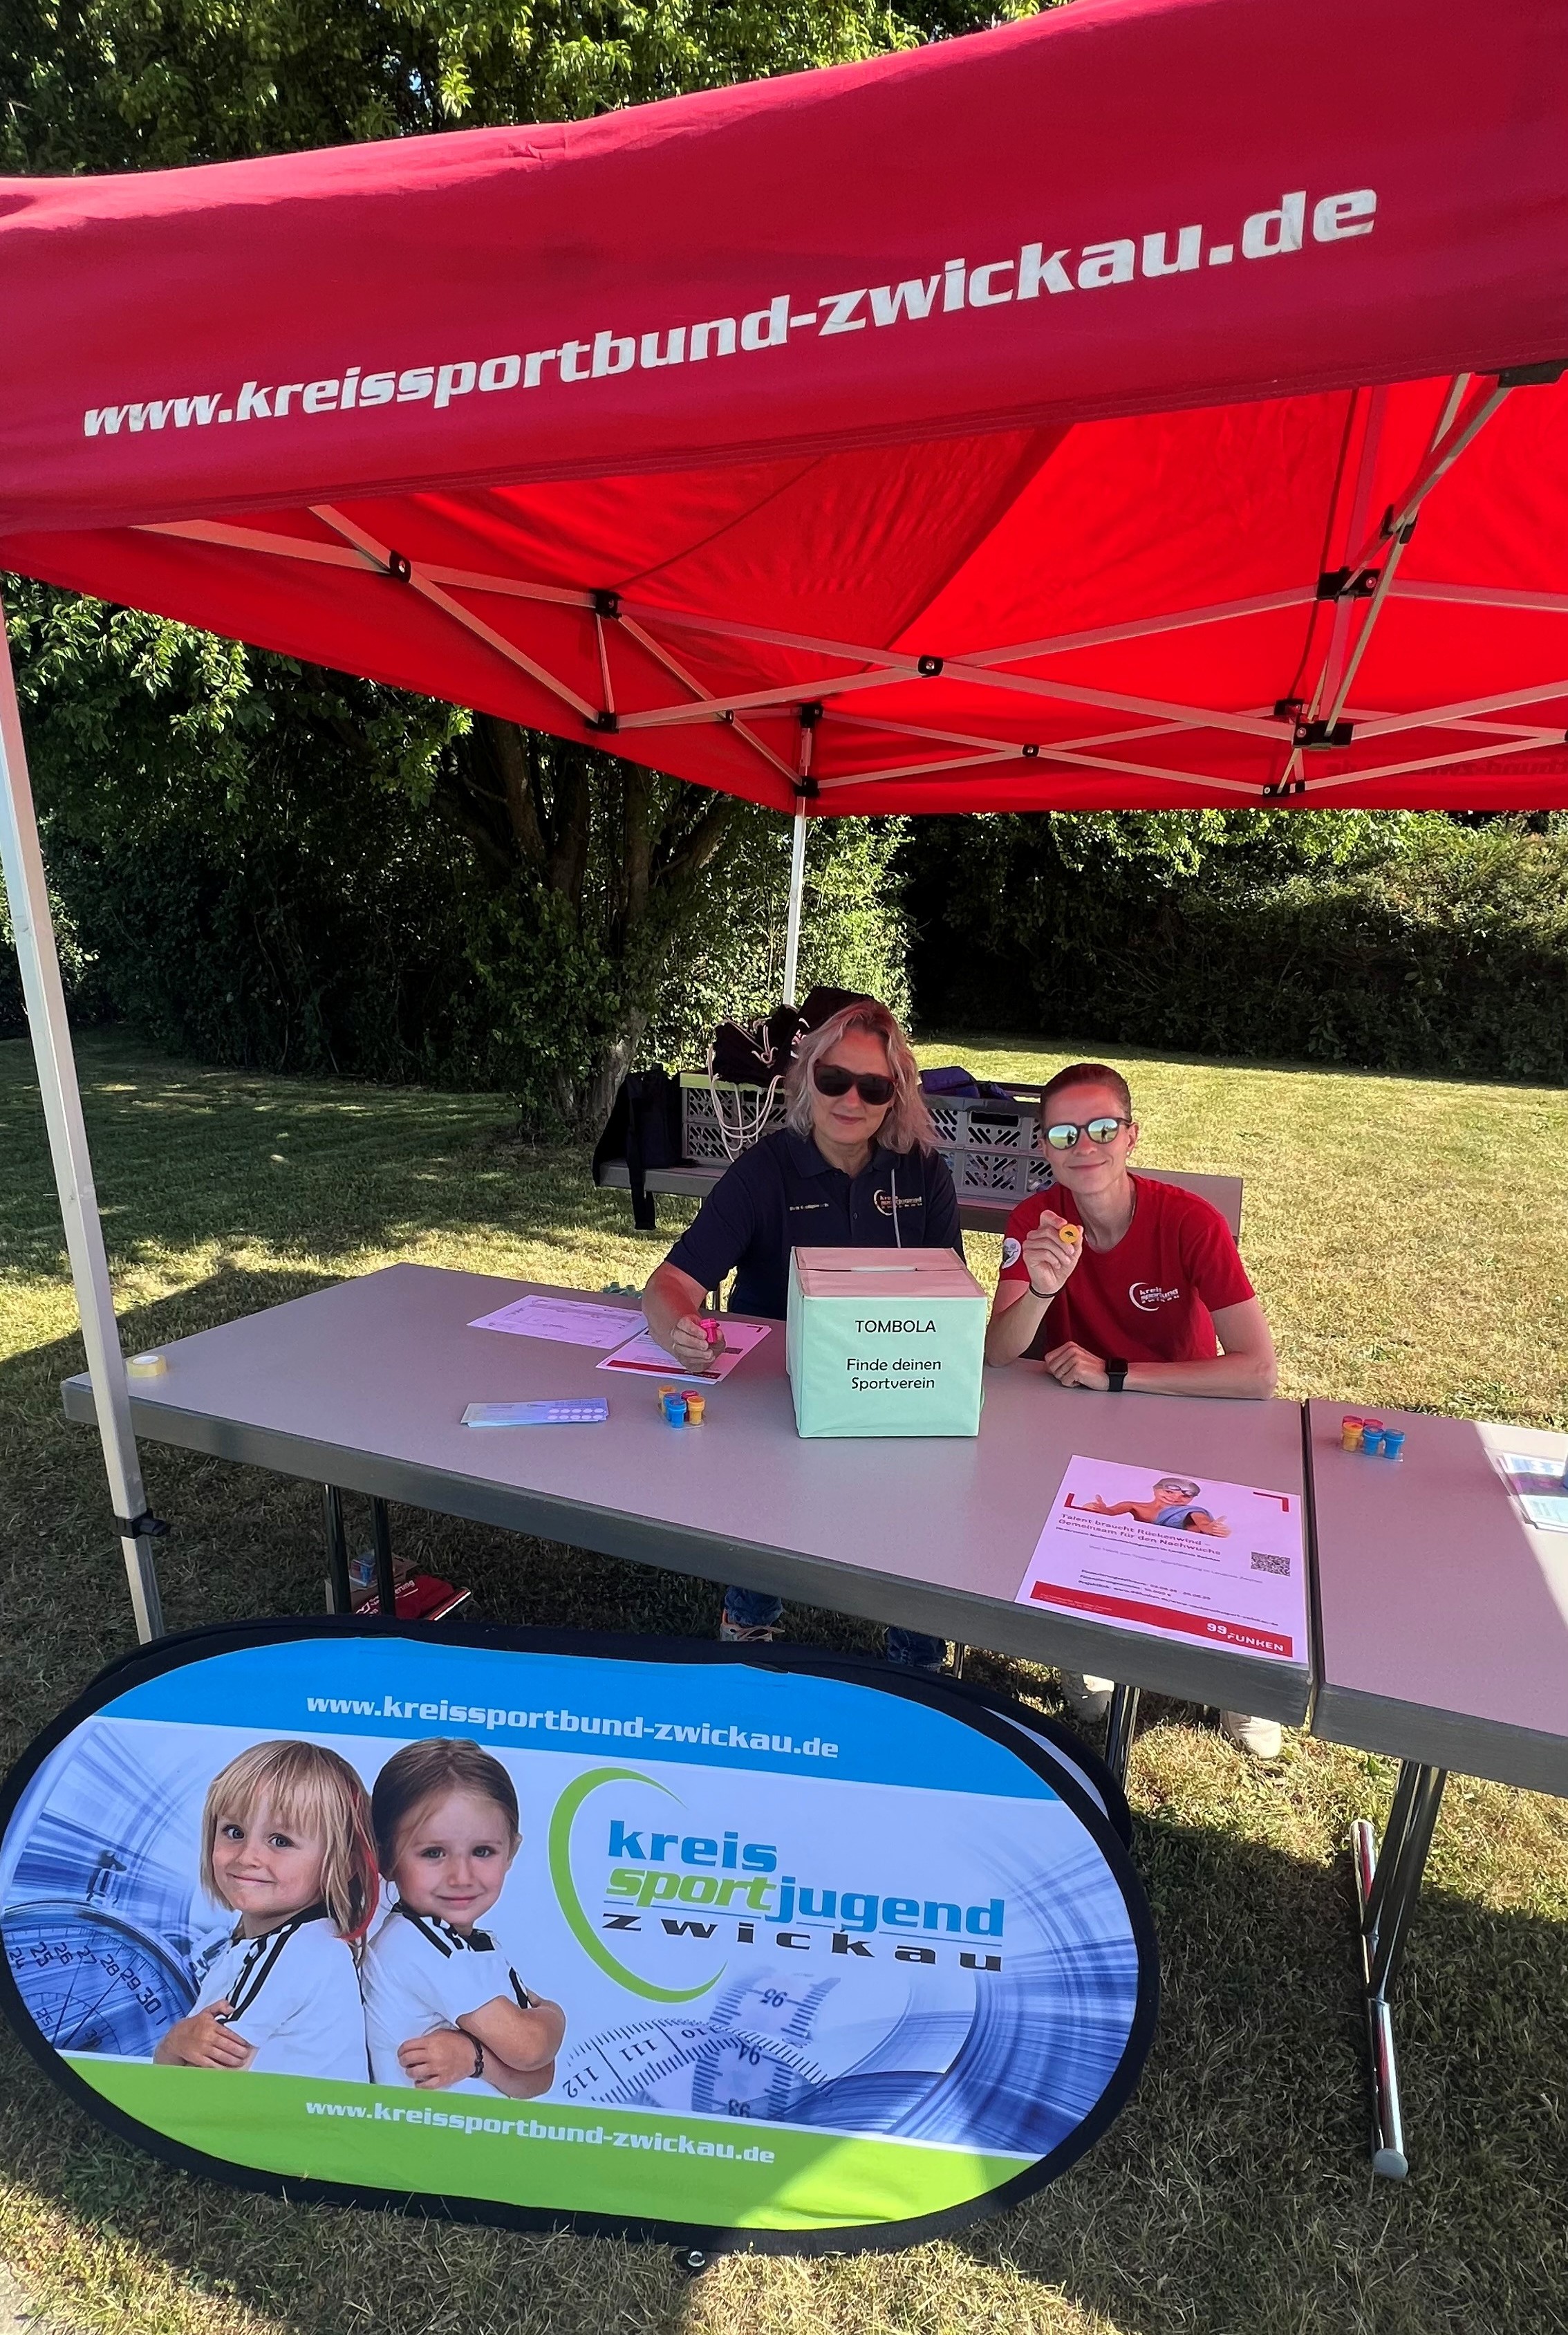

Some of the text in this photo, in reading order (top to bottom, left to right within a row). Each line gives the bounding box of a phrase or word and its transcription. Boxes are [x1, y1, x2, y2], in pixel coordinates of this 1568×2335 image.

[83, 189, 1376, 436] www.kreissportbund-zwickau.de
[855, 1320, 937, 1333] TOMBOLA
[847, 1358, 942, 1371] Finde deinen
[851, 1377, 935, 1391] Sportverein
[1058, 1519, 1117, 1535] Gemeinsam
[1159, 1539, 1220, 1555] Nachwuchs
[1062, 1514, 1092, 1523] Talent
[1095, 1520, 1135, 1532] braucht
[1137, 1529, 1202, 1545] Rückenwind
[307, 1695, 839, 1758] www.kreissportbund-zwickau.de
[608, 1820, 777, 1872] kreis
[606, 1868, 1005, 1937] sportjugend
[602, 1913, 1002, 1972] zwickau
[9, 1947, 25, 1970] 24
[30, 1942, 54, 1967] 25
[54, 1942, 73, 1964] 26
[77, 1945, 97, 1964] 27
[99, 1954, 120, 1977] 28
[120, 1968, 141, 1990] 29
[136, 1987, 162, 2014] 30
[760, 1988, 787, 2007] 95
[619, 2039, 658, 2063] 111
[738, 2040, 763, 2066] 94
[562, 2065, 599, 2098] 112
[306, 2100, 775, 2164] www.kreissportbund-zwickau.de
